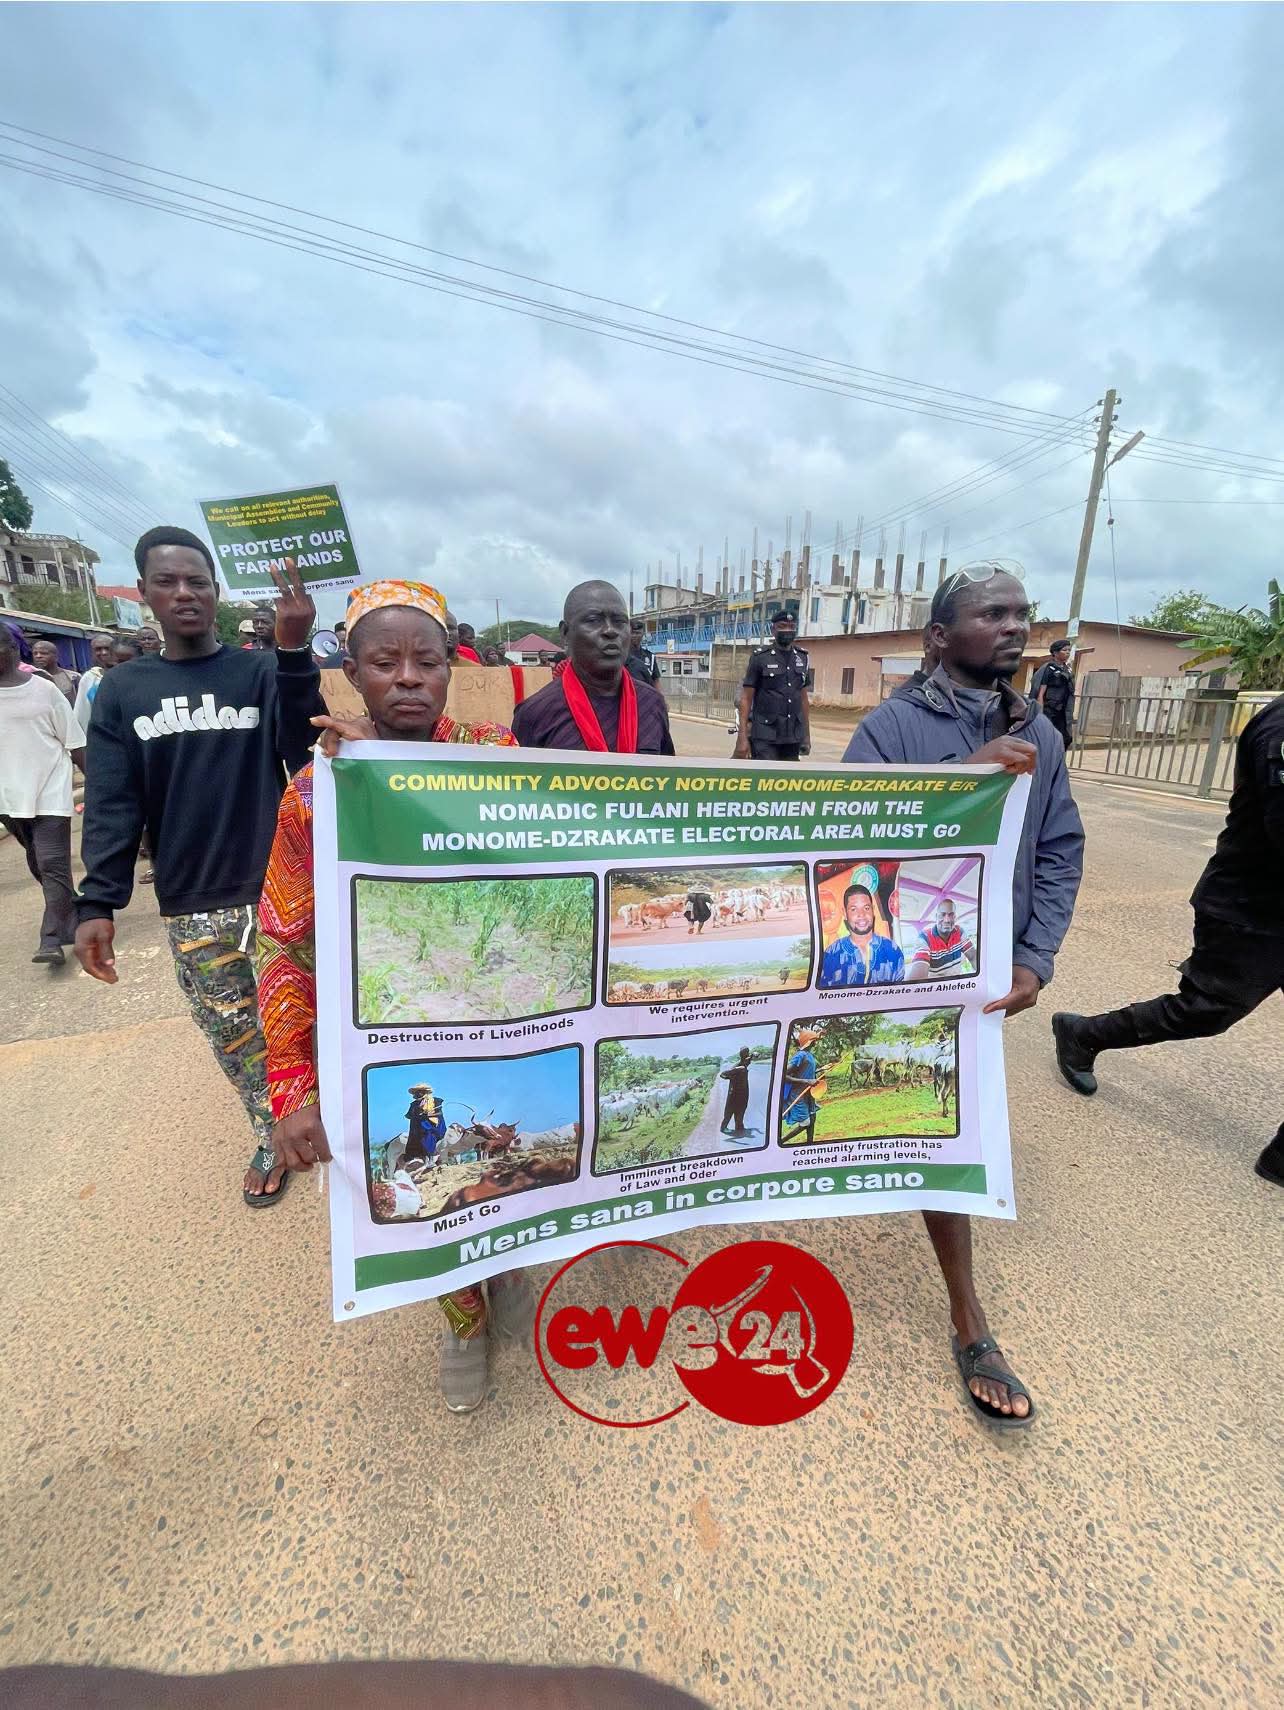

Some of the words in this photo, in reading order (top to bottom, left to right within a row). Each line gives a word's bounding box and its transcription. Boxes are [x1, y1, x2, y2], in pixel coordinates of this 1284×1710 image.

[208, 513, 244, 522] Municipal
[246, 508, 286, 518] Assemblies
[288, 505, 300, 513] and
[302, 500, 339, 510] Community
[225, 505, 239, 513] call
[252, 502, 260, 510] all
[262, 499, 290, 509] relevant
[227, 518, 258, 527] Leaders
[259, 516, 266, 524] to
[268, 515, 280, 523] act
[281, 512, 307, 521] without
[308, 509, 326, 517] delay
[218, 535, 304, 558] PROTECT
[310, 529, 347, 546] OUR
[234, 549, 343, 574] FARMANDS
[134, 694, 260, 740] adidas
[388, 774, 542, 791] COMMUNITY
[549, 775, 670, 792] ADVOCACY
[675, 777, 752, 791] NOTICE
[757, 778, 946, 792] MONOME-DZRAKATE
[479, 802, 597, 821] NOMADIC
[605, 802, 689, 819] FULANI
[696, 801, 816, 818] HERDSMEN
[822, 800, 878, 816] FROM
[885, 800, 924, 815] THE
[422, 828, 675, 851] MONOME-DZRAKATE
[682, 825, 804, 843] ELECTORAL
[810, 824, 864, 840] AREA
[870, 824, 928, 838] MUST
[934, 824, 960, 837] GO
[818, 988, 912, 1000] Monome-Dzrakate
[914, 985, 932, 994] and
[649, 1005, 668, 1015] We
[672, 1000, 724, 1014] requires
[728, 997, 769, 1010] urgent
[670, 1008, 750, 1024] intervention.
[367, 1031, 464, 1044] Destruction
[469, 1030, 485, 1041] of
[490, 1018, 574, 1039] Livelihoods
[792, 1144, 855, 1156] community
[857, 1140, 918, 1151] frustration
[921, 1140, 942, 1149] has
[792, 1155, 838, 1167] reached
[841, 1152, 890, 1163] alarming
[893, 1150, 931, 1161] levels,
[620, 1166, 677, 1183] Imminent
[680, 1155, 744, 1172] breakdown
[620, 1182, 632, 1193] of
[635, 1177, 660, 1190] Law
[664, 1174, 685, 1185] and
[689, 1168, 717, 1180] Oder
[433, 1210, 474, 1233] Must
[479, 1203, 501, 1216] Go
[460, 1218, 558, 1263] Mens
[570, 1199, 653, 1230] sana
[666, 1192, 694, 1210] in
[706, 1176, 835, 1203] corpore
[845, 1171, 924, 1191] sano
